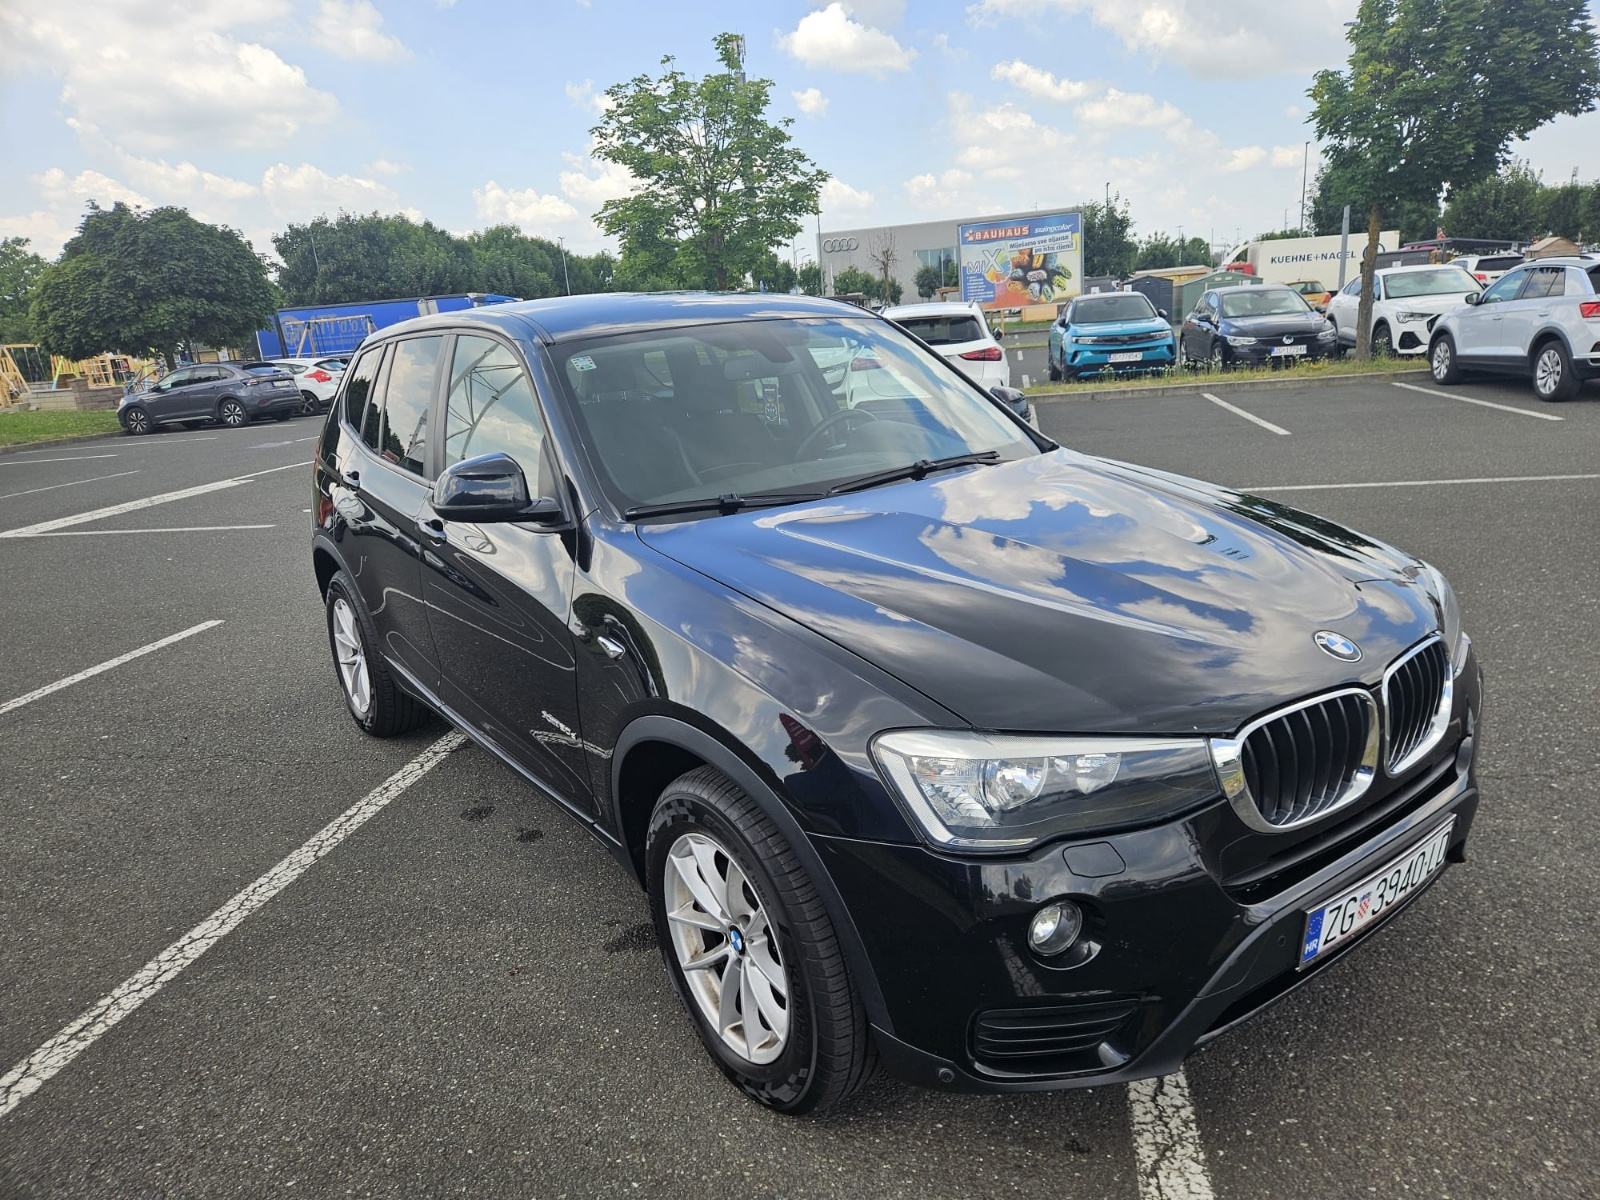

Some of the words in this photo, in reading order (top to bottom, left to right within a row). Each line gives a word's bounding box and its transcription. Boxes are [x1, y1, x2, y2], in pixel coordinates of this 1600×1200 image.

[975, 226, 1029, 240] BAUHAUS
[1035, 224, 1073, 234] swingcolor
[1323, 897, 1357, 945] ZG
[1304, 938, 1319, 955] HR
